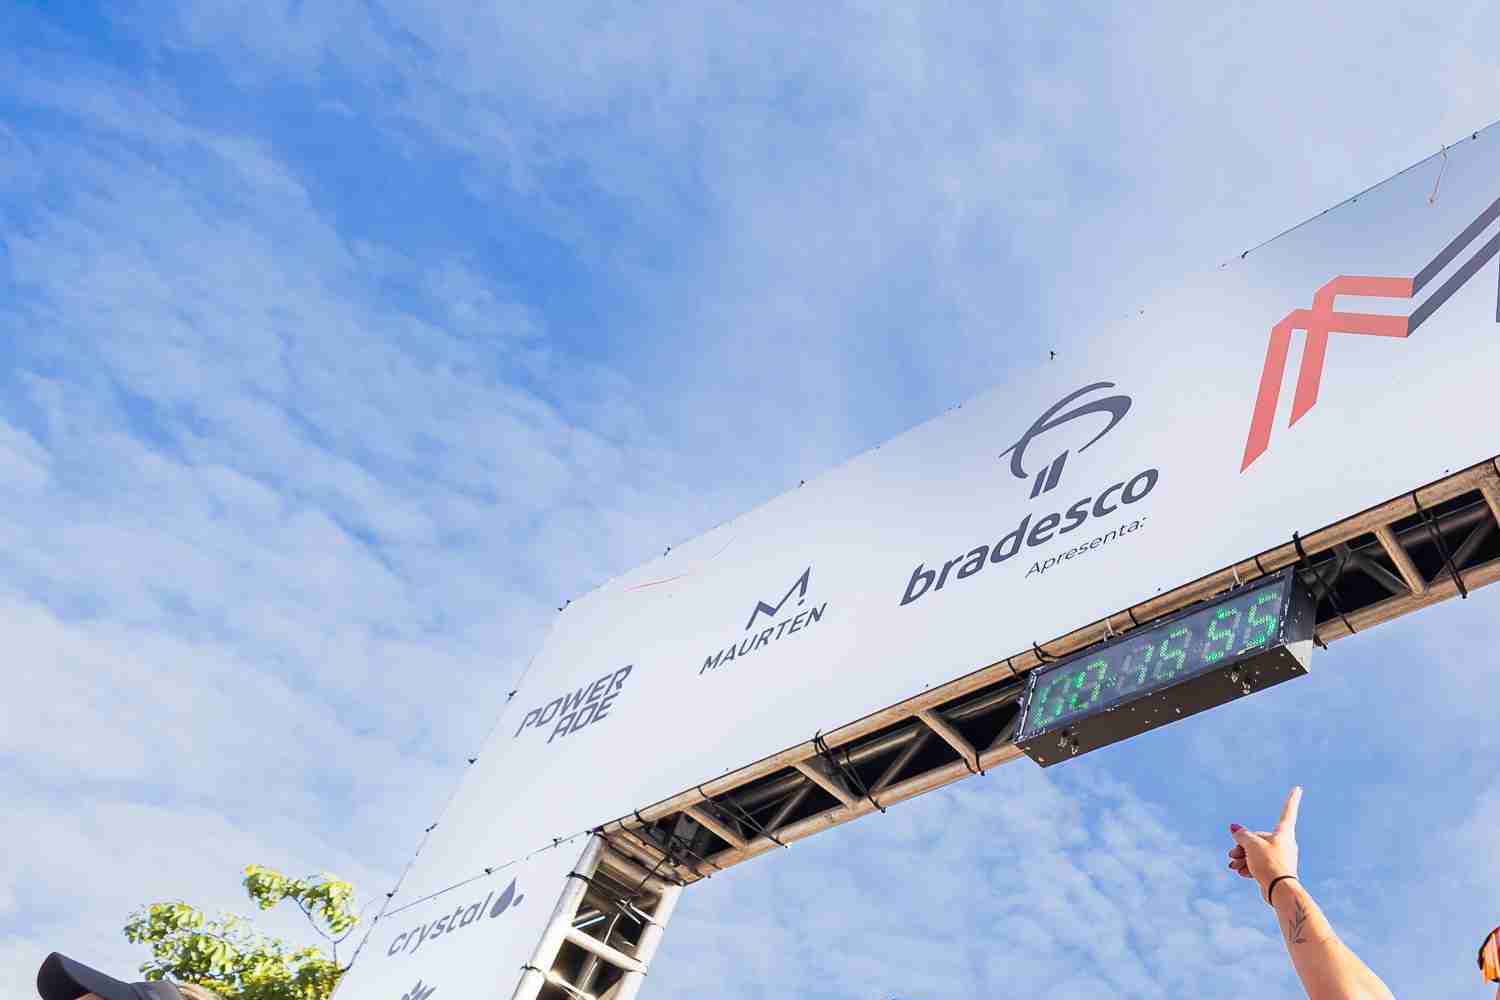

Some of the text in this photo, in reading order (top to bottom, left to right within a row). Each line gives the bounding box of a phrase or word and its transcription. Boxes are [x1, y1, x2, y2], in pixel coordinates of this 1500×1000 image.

[900, 468, 1159, 606] bradesco
[1025, 517, 1147, 579] Apresenta:
[699, 602, 828, 675] MAURTEN
[513, 664, 633, 738] POWER
[547, 691, 620, 744] ADE
[387, 892, 489, 957] crystal
